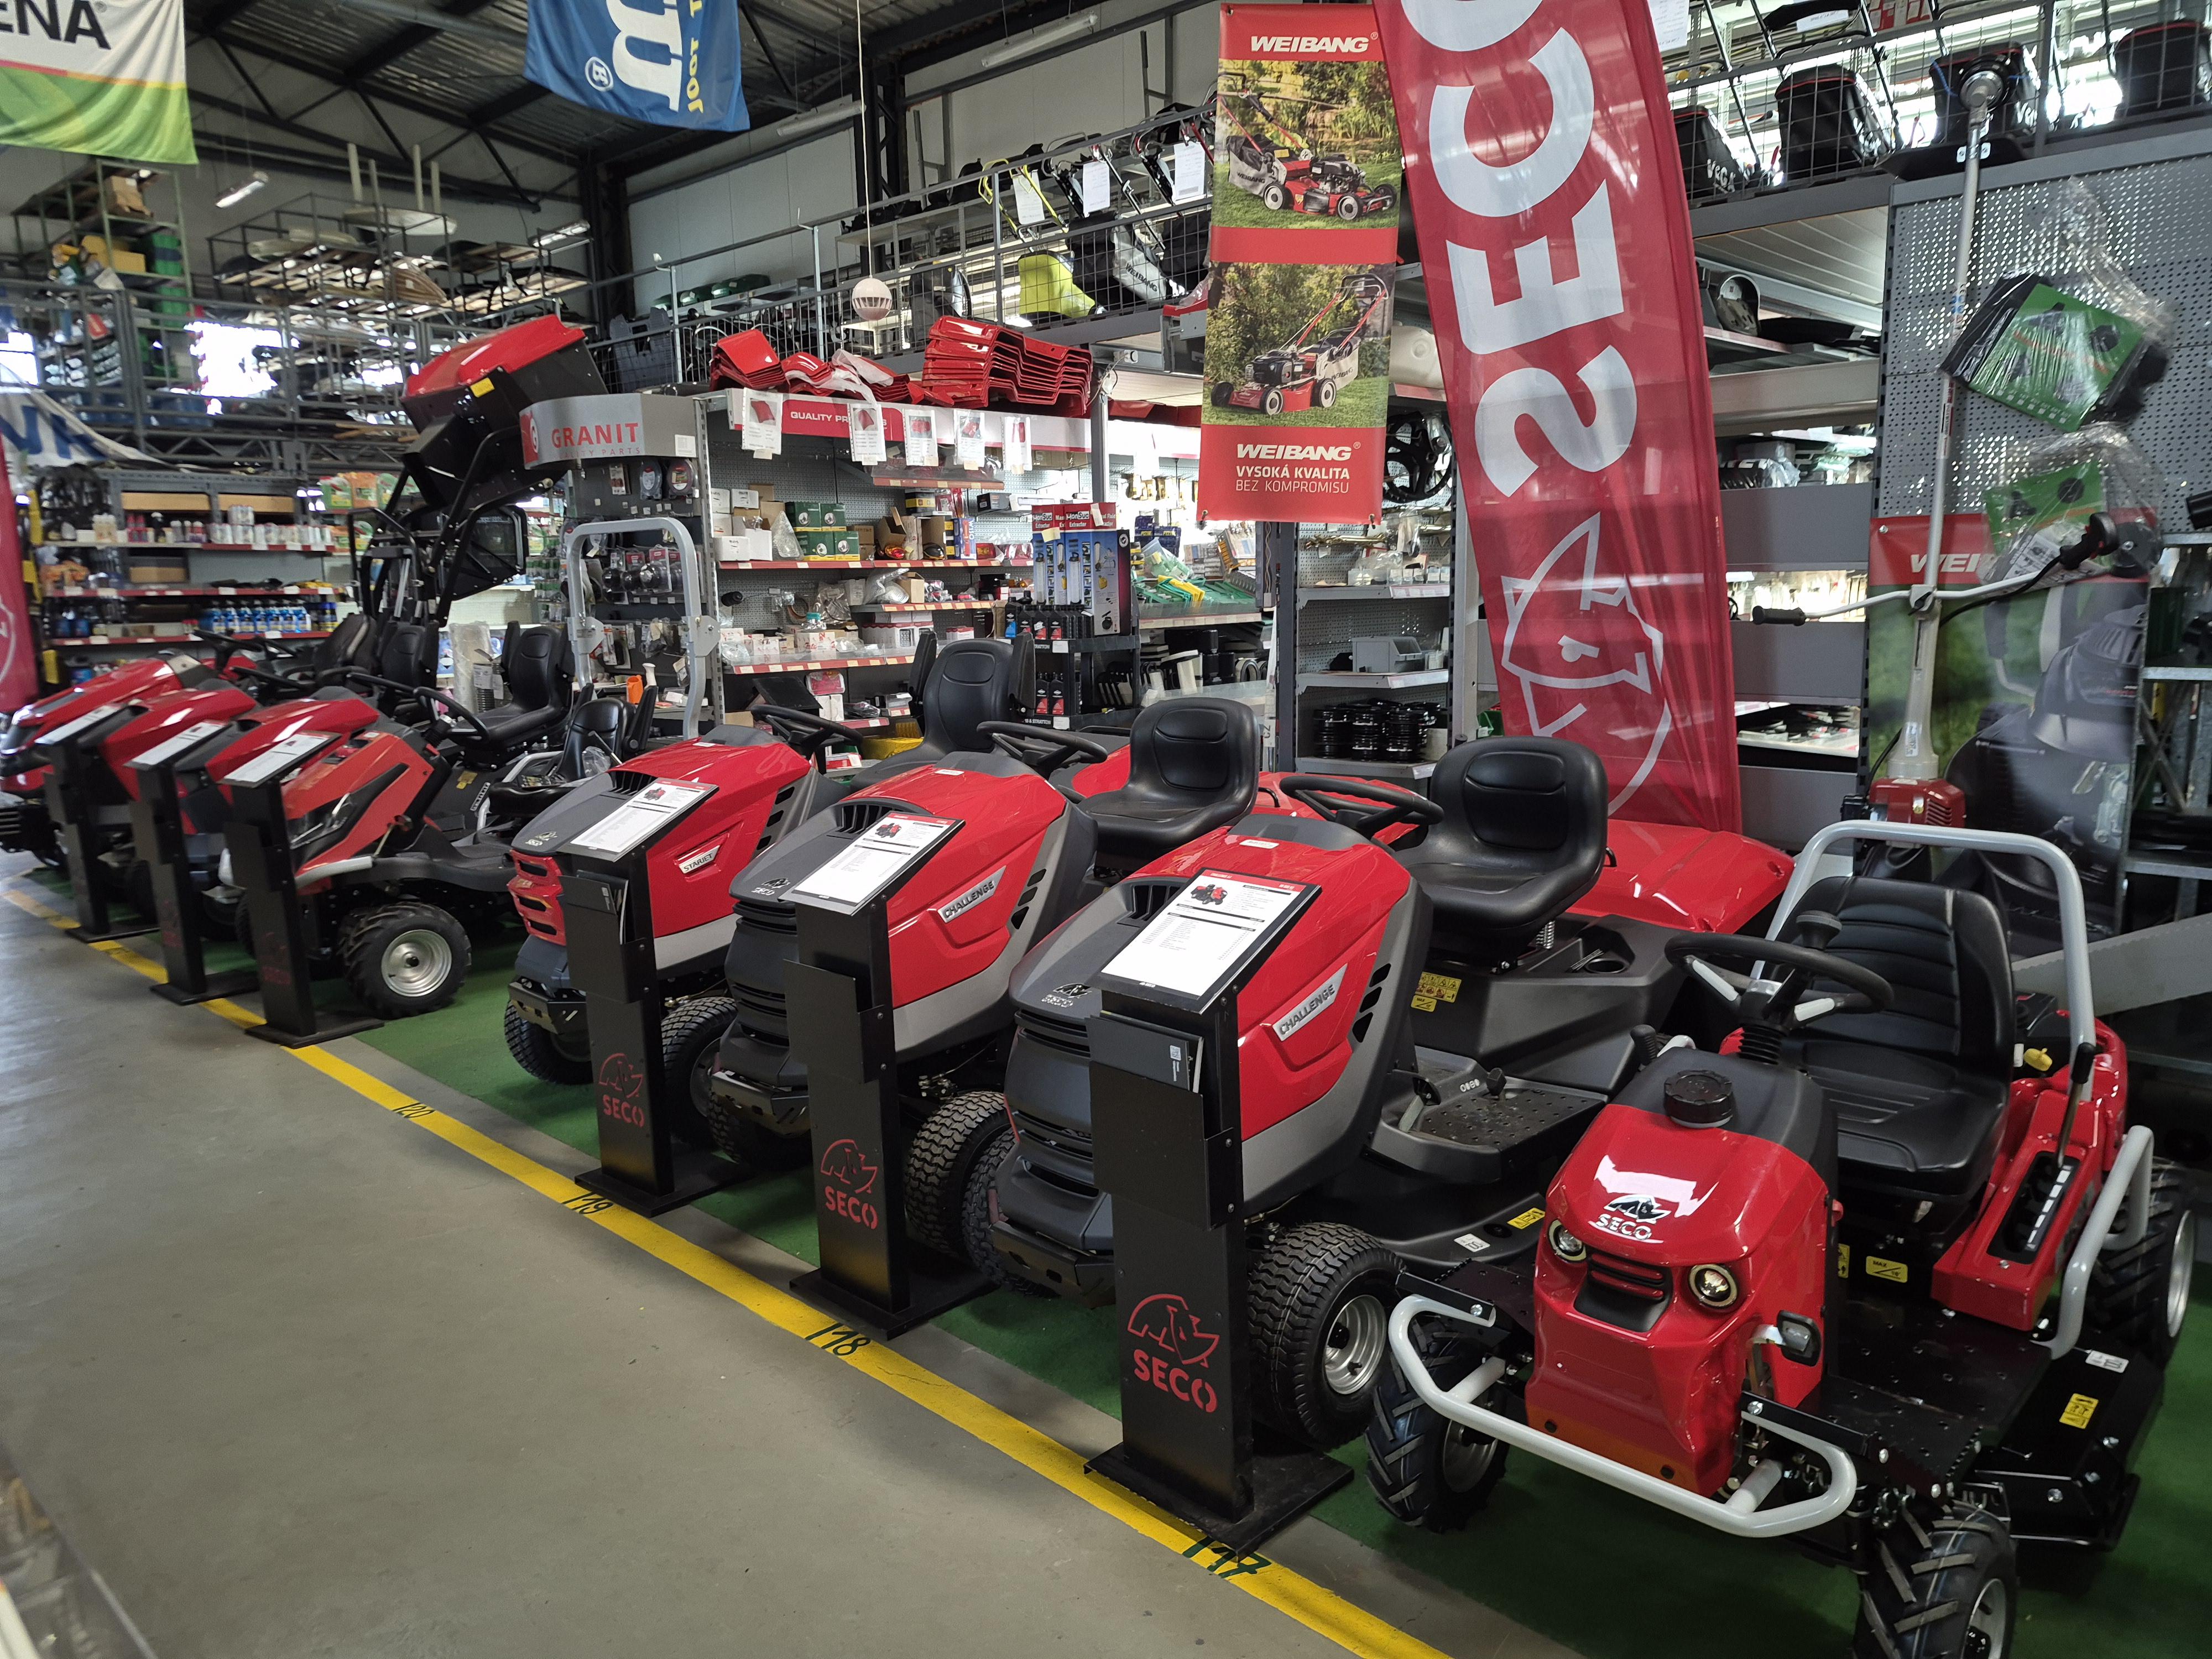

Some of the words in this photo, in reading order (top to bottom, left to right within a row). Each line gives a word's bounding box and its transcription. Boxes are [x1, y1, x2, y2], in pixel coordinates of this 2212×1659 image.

[790, 411, 833, 422] QUALITY
[551, 422, 639, 449] GRANIT
[601, 446, 641, 456] PARTS
[1236, 464, 1290, 479] VYSOKÁ
[1294, 465, 1350, 481] KVALITA
[1235, 479, 1259, 492] BEZ
[1263, 479, 1349, 494] KOMPROMISU
[1066, 510, 1090, 520] MonSuc
[683, 852, 713, 872] STARJET
[943, 880, 995, 920] CHALLENGE
[1279, 983, 1335, 1035] CHALLENGE
[392, 1102, 435, 1118] 120
[602, 1094, 645, 1128] SECO
[562, 1191, 613, 1215] 119
[825, 1186, 879, 1229] SECO
[1595, 1213, 1652, 1241] SECO
[805, 1322, 872, 1356] 118
[1133, 1349, 1218, 1414] SECO
